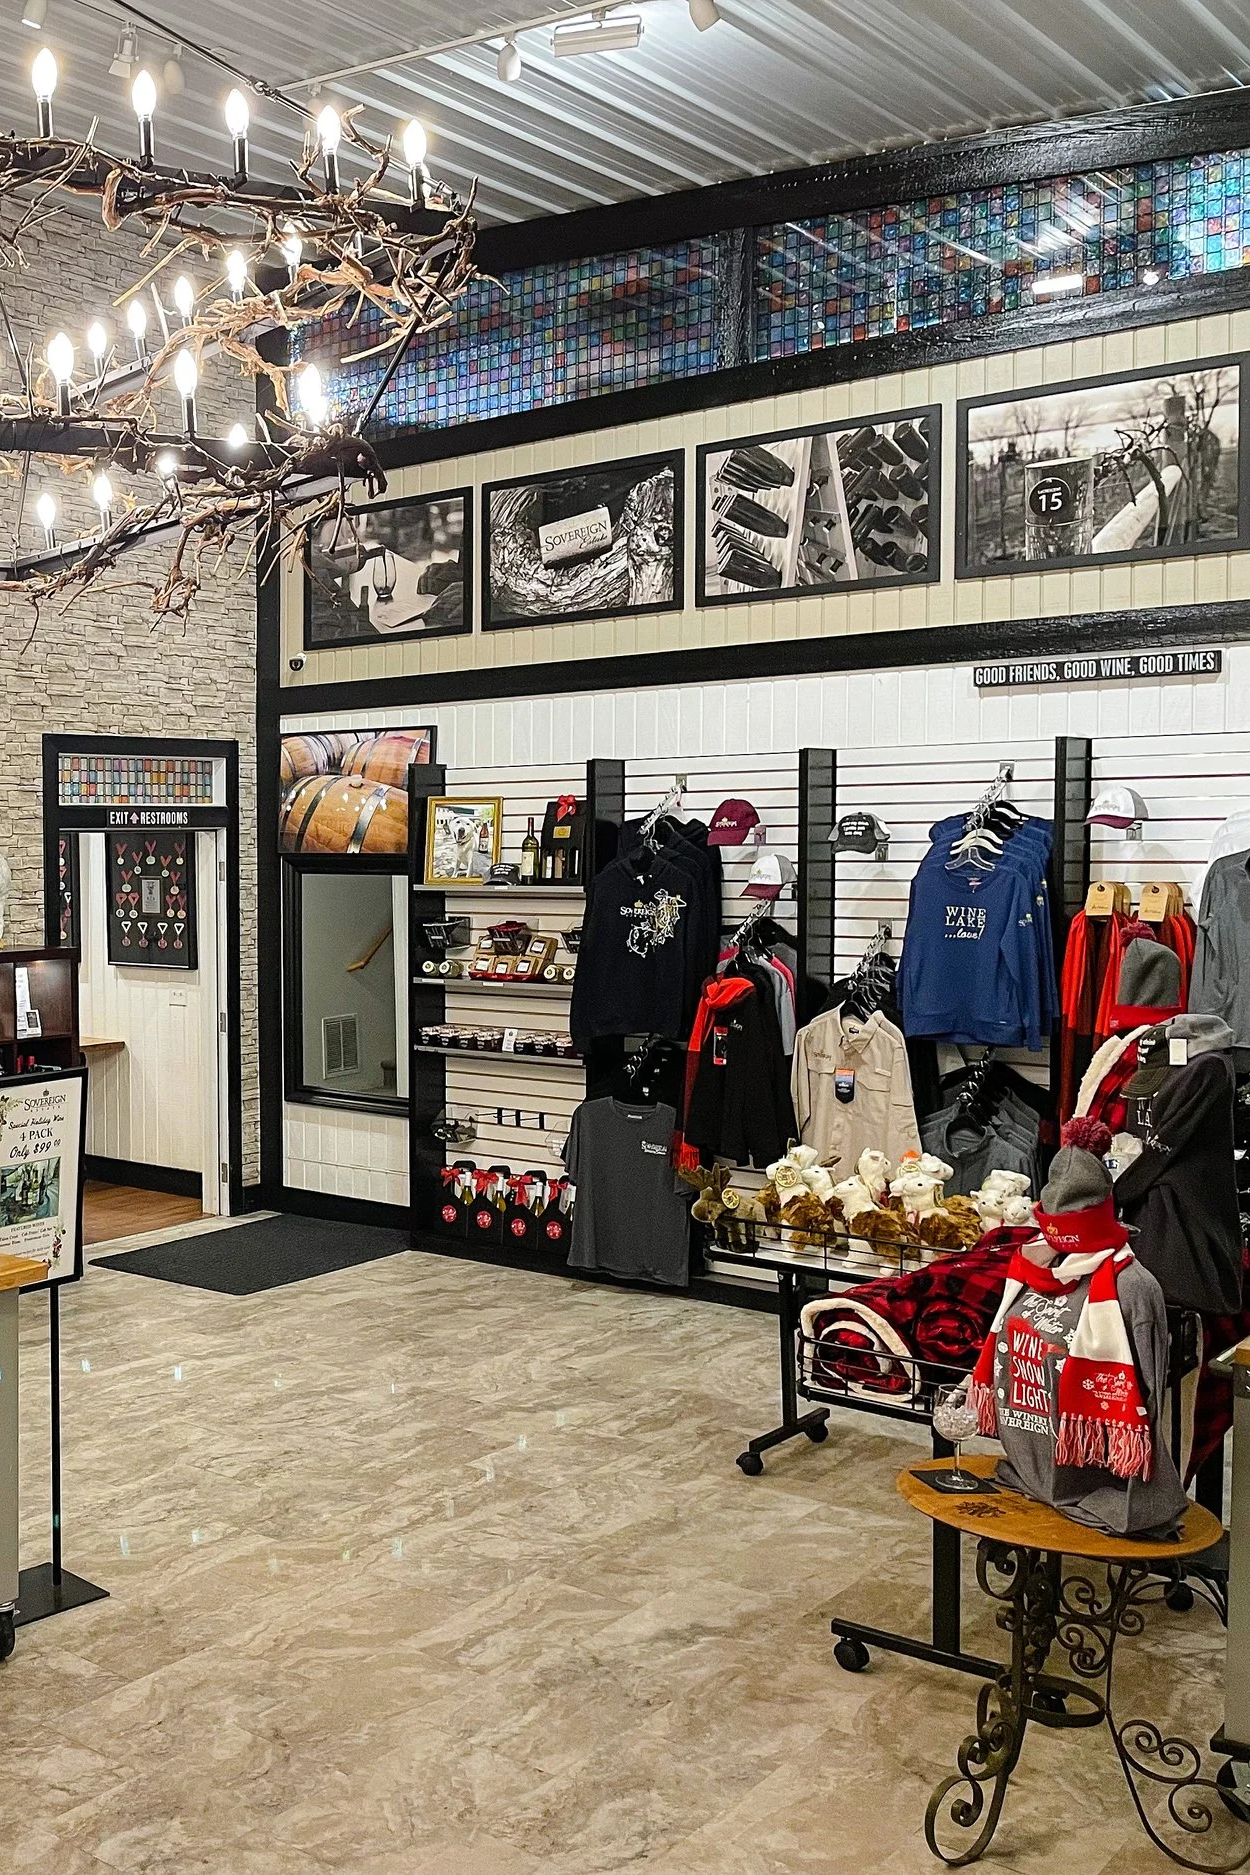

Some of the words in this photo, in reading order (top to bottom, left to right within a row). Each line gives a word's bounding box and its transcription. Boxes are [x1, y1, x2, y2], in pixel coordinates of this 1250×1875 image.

[1038, 492, 1062, 512] 15
[545, 520, 607, 551] SOVEREIGN
[975, 667, 1006, 685] GOOD
[1009, 663, 1060, 682] FRIENDS,
[1064, 660, 1096, 679] GOOD
[1100, 658, 1135, 676] WINE,
[1139, 655, 1174, 674] GOOD
[1177, 652, 1215, 672] TIMES
[110, 811, 129, 825] EXIT
[140, 811, 188, 825] RESTROOMS
[945, 906, 986, 918] WINE
[945, 915, 986, 928] LAKE
[24, 1095, 66, 1111] SOVEREIGN
[8, 1119, 30, 1130] Special
[19, 1132, 26, 1142] 4
[29, 1127, 53, 1140] PACK
[9, 1144, 30, 1159] Only
[33, 1140, 52, 1154] $99
[1023, 1292, 1049, 1308] The
[1013, 1329, 1044, 1361] WINE
[1012, 1355, 1046, 1387] SNOW
